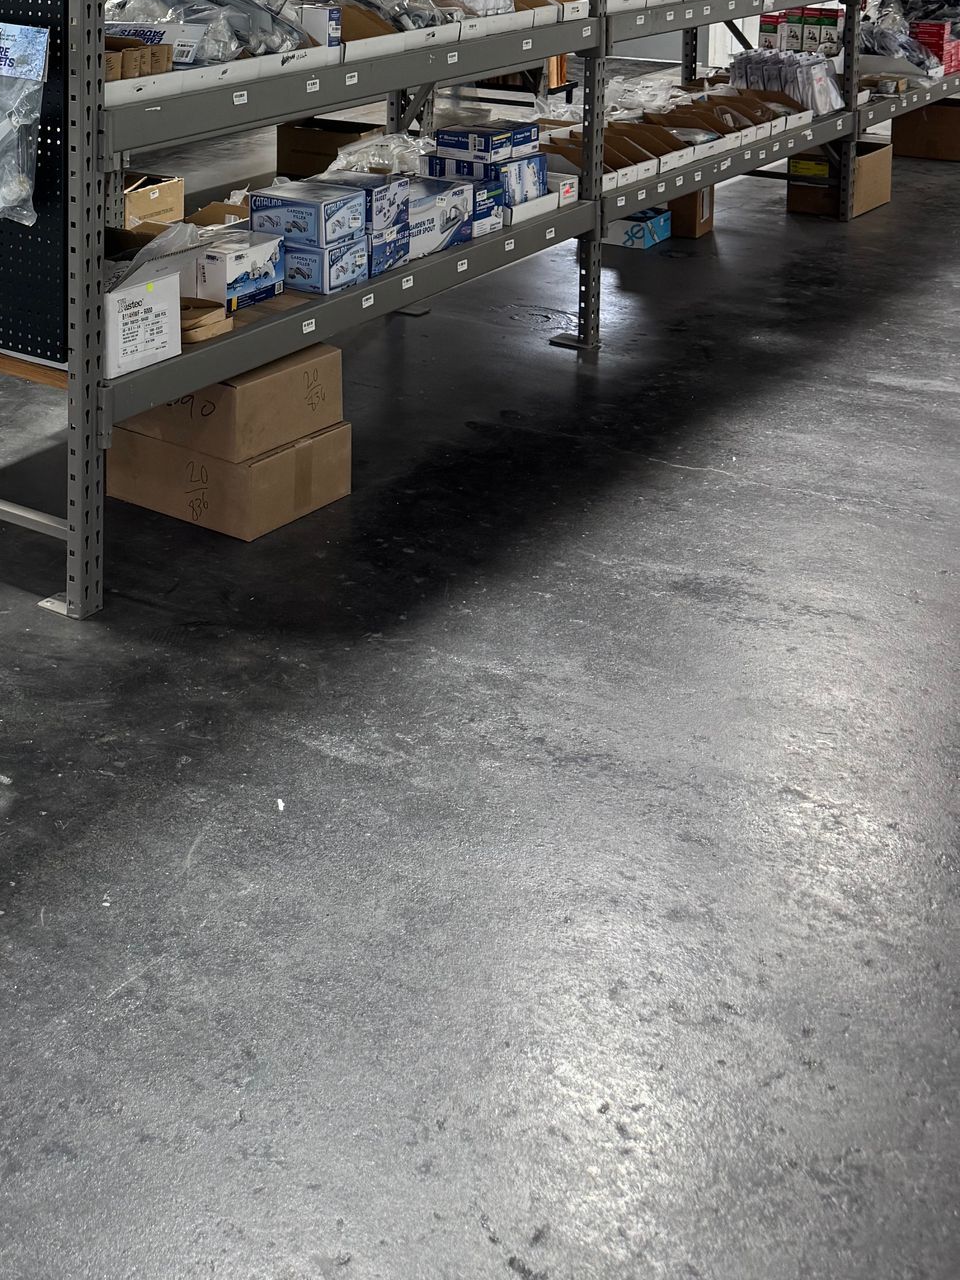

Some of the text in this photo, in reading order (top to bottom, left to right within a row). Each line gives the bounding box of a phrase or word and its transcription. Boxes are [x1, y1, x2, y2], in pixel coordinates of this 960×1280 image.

[120, 29, 167, 38] FAUCETS
[251, 198, 282, 210] CATALINA
[409, 221, 426, 231] GARDEN
[422, 225, 436, 236] SPOUT
[303, 368, 319, 390] 20
[185, 460, 209, 484] 20
[188, 492, 209, 521] 836
